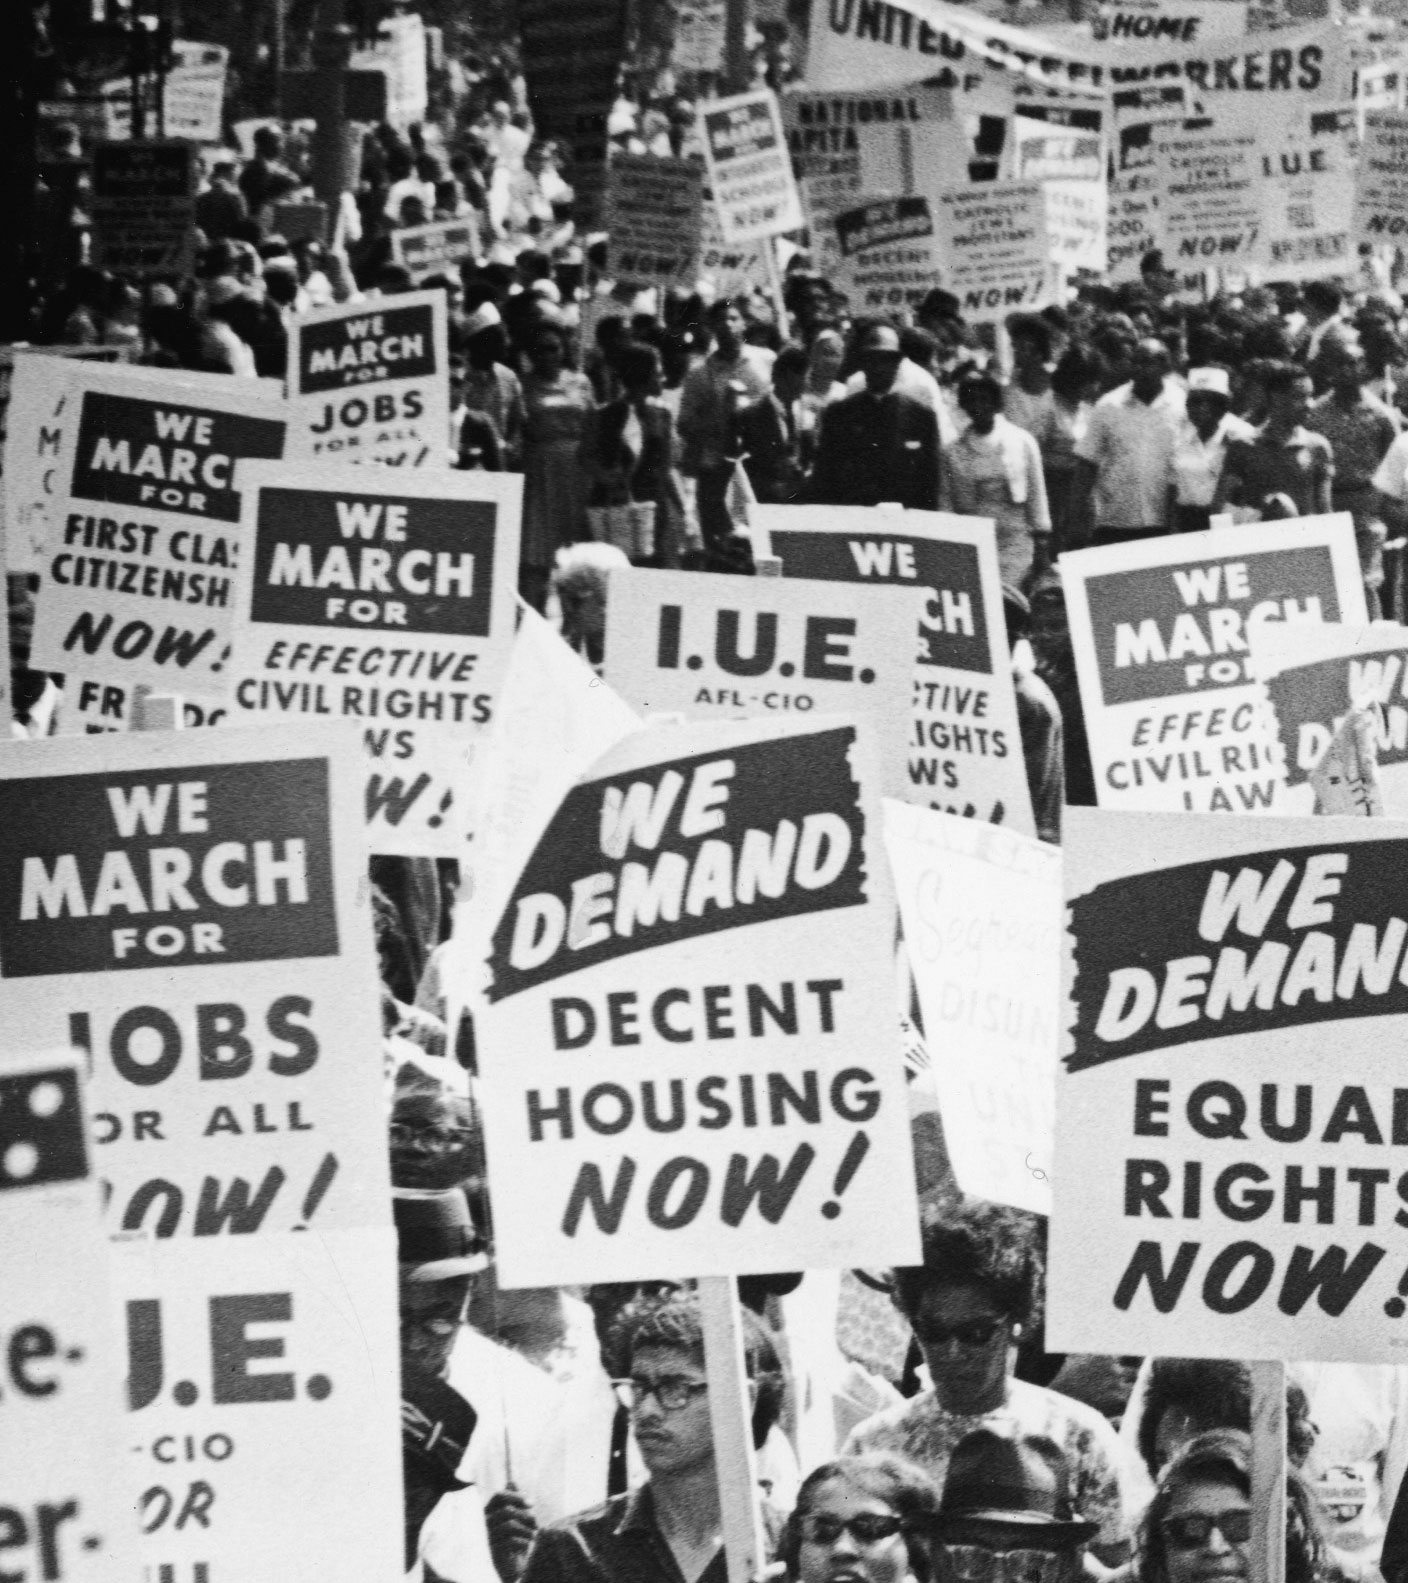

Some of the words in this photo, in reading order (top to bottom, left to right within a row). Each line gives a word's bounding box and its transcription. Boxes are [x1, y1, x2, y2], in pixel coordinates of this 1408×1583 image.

[1109, 13, 1199, 41] HOME
[797, 99, 920, 122] NATIONAL
[345, 315, 385, 340] WE
[309, 333, 424, 375] MARCH
[343, 366, 389, 383] FOR
[153, 409, 216, 446] WE
[309, 390, 424, 434] JOBS
[90, 436, 234, 490] MARC
[313, 437, 361, 454] FOR
[376, 428, 422, 445] ALL
[140, 484, 208, 512] FOR
[64, 513, 159, 557] FIRST
[168, 530, 239, 570] CLA
[335, 501, 410, 542] WE
[50, 552, 231, 609] CITIZENSH
[268, 541, 476, 598] MARCH
[848, 540, 917, 580] WE
[1172, 561, 1251, 607] WE
[325, 597, 408, 626] FOR
[62, 610, 232, 674] NOW!
[264, 640, 479, 682] EFFECTIVE
[657, 603, 876, 685] I.U.E.
[1184, 656, 1256, 688] FO
[235, 678, 332, 716] CIVIL
[342, 685, 493, 725] RIGHTS
[693, 687, 815, 712] AFL-CIO
[909, 718, 1009, 760] IGHTS
[1131, 702, 1255, 749] EFFEC
[1105, 750, 1213, 791] CIVIL
[105, 781, 210, 838] WE
[599, 758, 736, 860] WE
[18, 838, 310, 921] MARCH
[508, 812, 853, 972] DEMAND
[1198, 852, 1350, 943] WE
[110, 921, 226, 959] FOR
[549, 977, 845, 1051] DECENT
[91, 1110, 167, 1145] OR
[202, 1101, 315, 1138] ALL
[525, 1065, 884, 1142] HOUSING
[100, 1150, 340, 1240] OW!
[560, 1129, 872, 1239] NOW!
[131, 1432, 234, 1464] -CIO
[139, 1478, 216, 1535] OR
